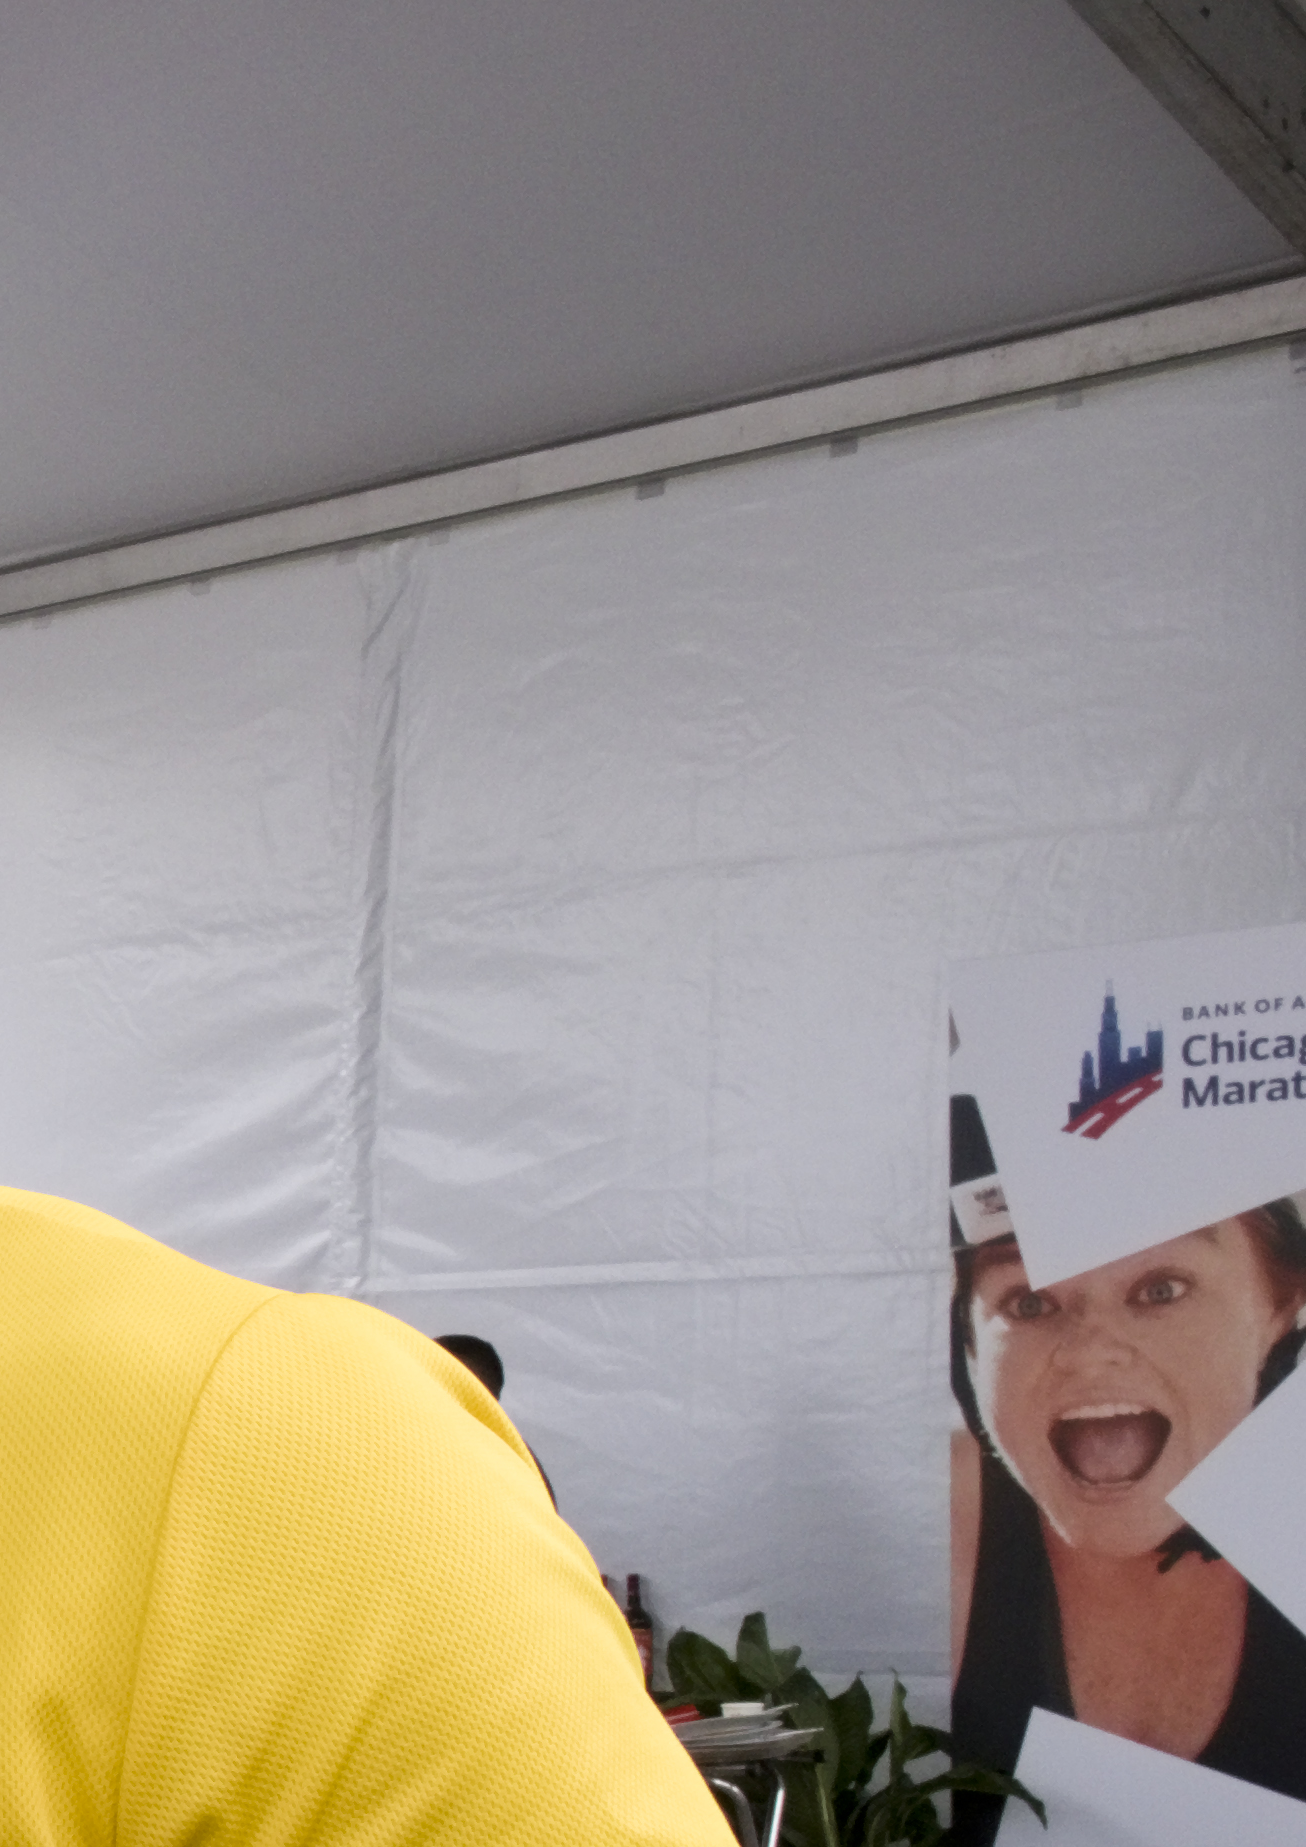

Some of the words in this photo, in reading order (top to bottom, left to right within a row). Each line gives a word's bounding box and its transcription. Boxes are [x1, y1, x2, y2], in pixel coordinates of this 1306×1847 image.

[1182, 1001, 1246, 1021] BANK
[1254, 998, 1284, 1014] OF
[1292, 995, 1306, 1011] A
[1182, 1070, 1306, 1109] Marat
